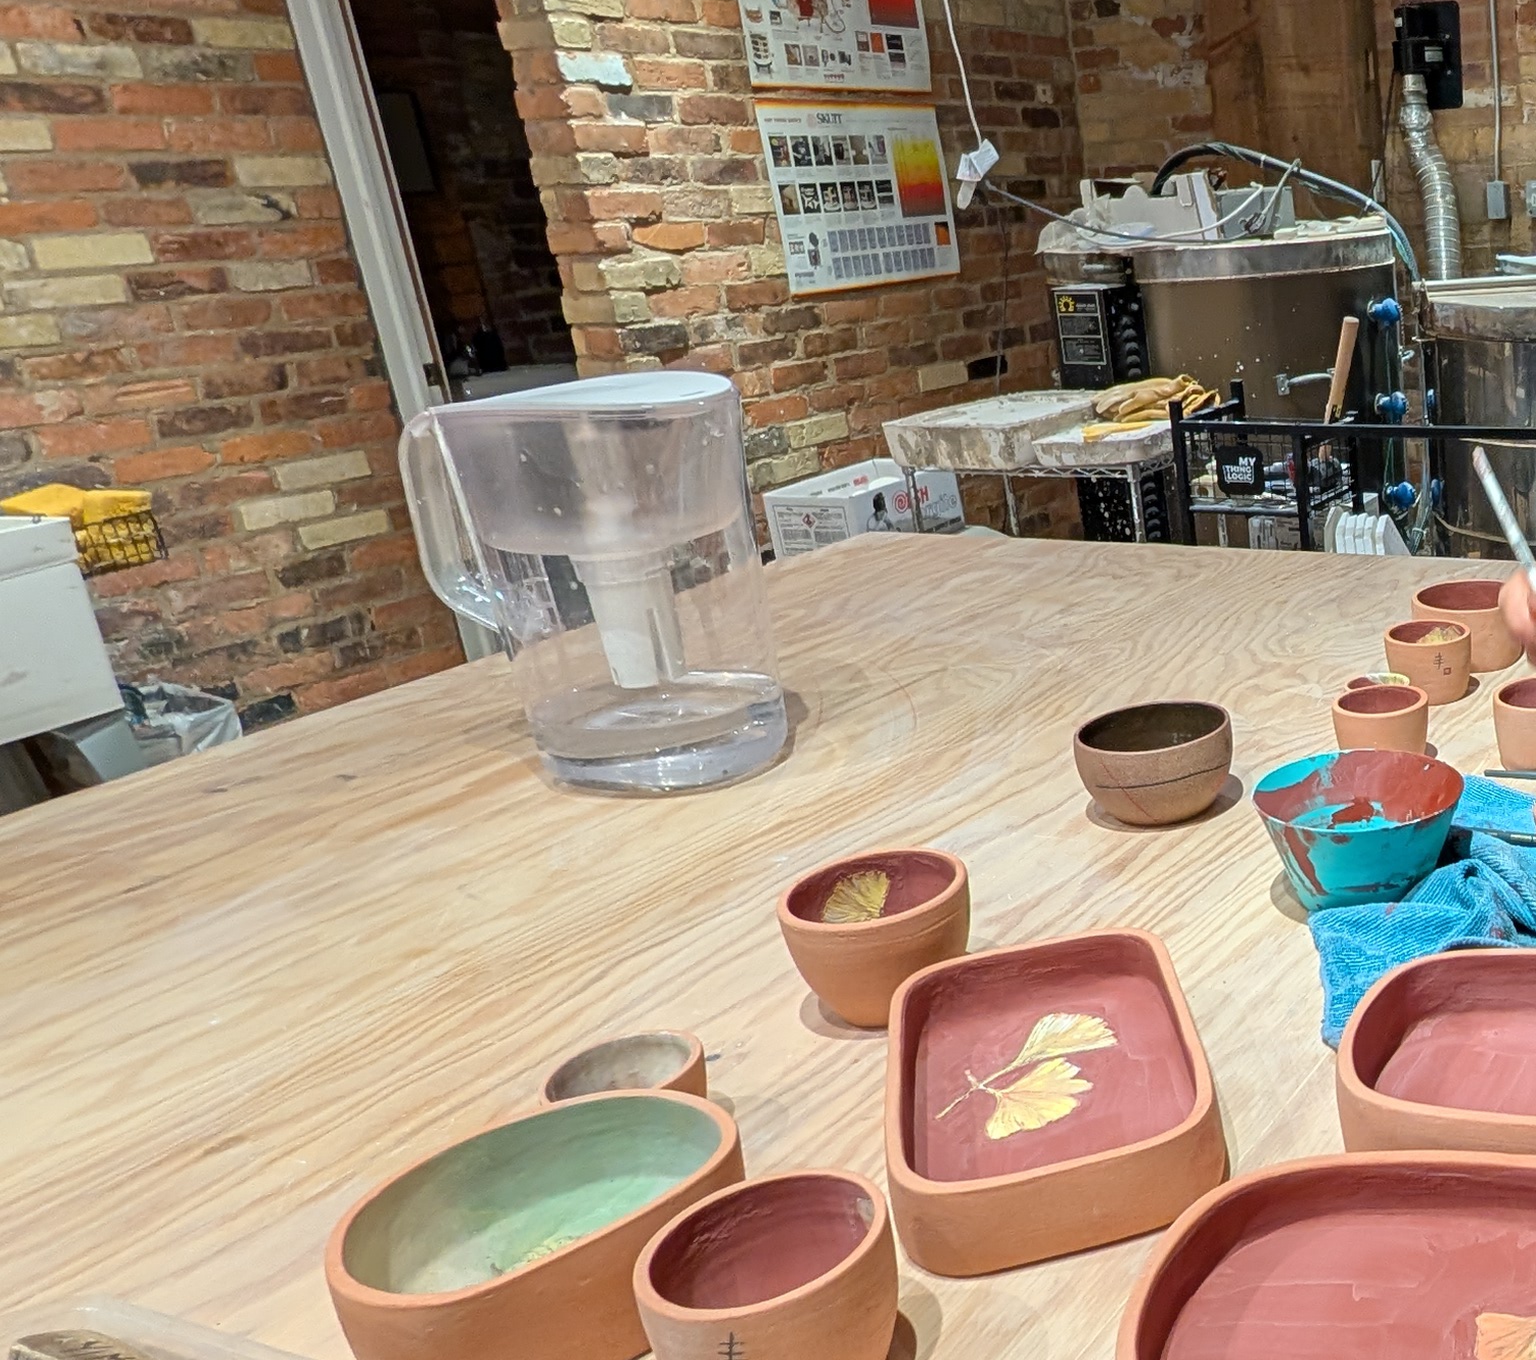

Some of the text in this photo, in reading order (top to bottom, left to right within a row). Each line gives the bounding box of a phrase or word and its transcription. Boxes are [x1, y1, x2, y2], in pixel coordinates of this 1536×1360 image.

[816, 112, 842, 125] SKUTT
[1238, 456, 1257, 467] MY
[1227, 472, 1252, 481] LOGIC
